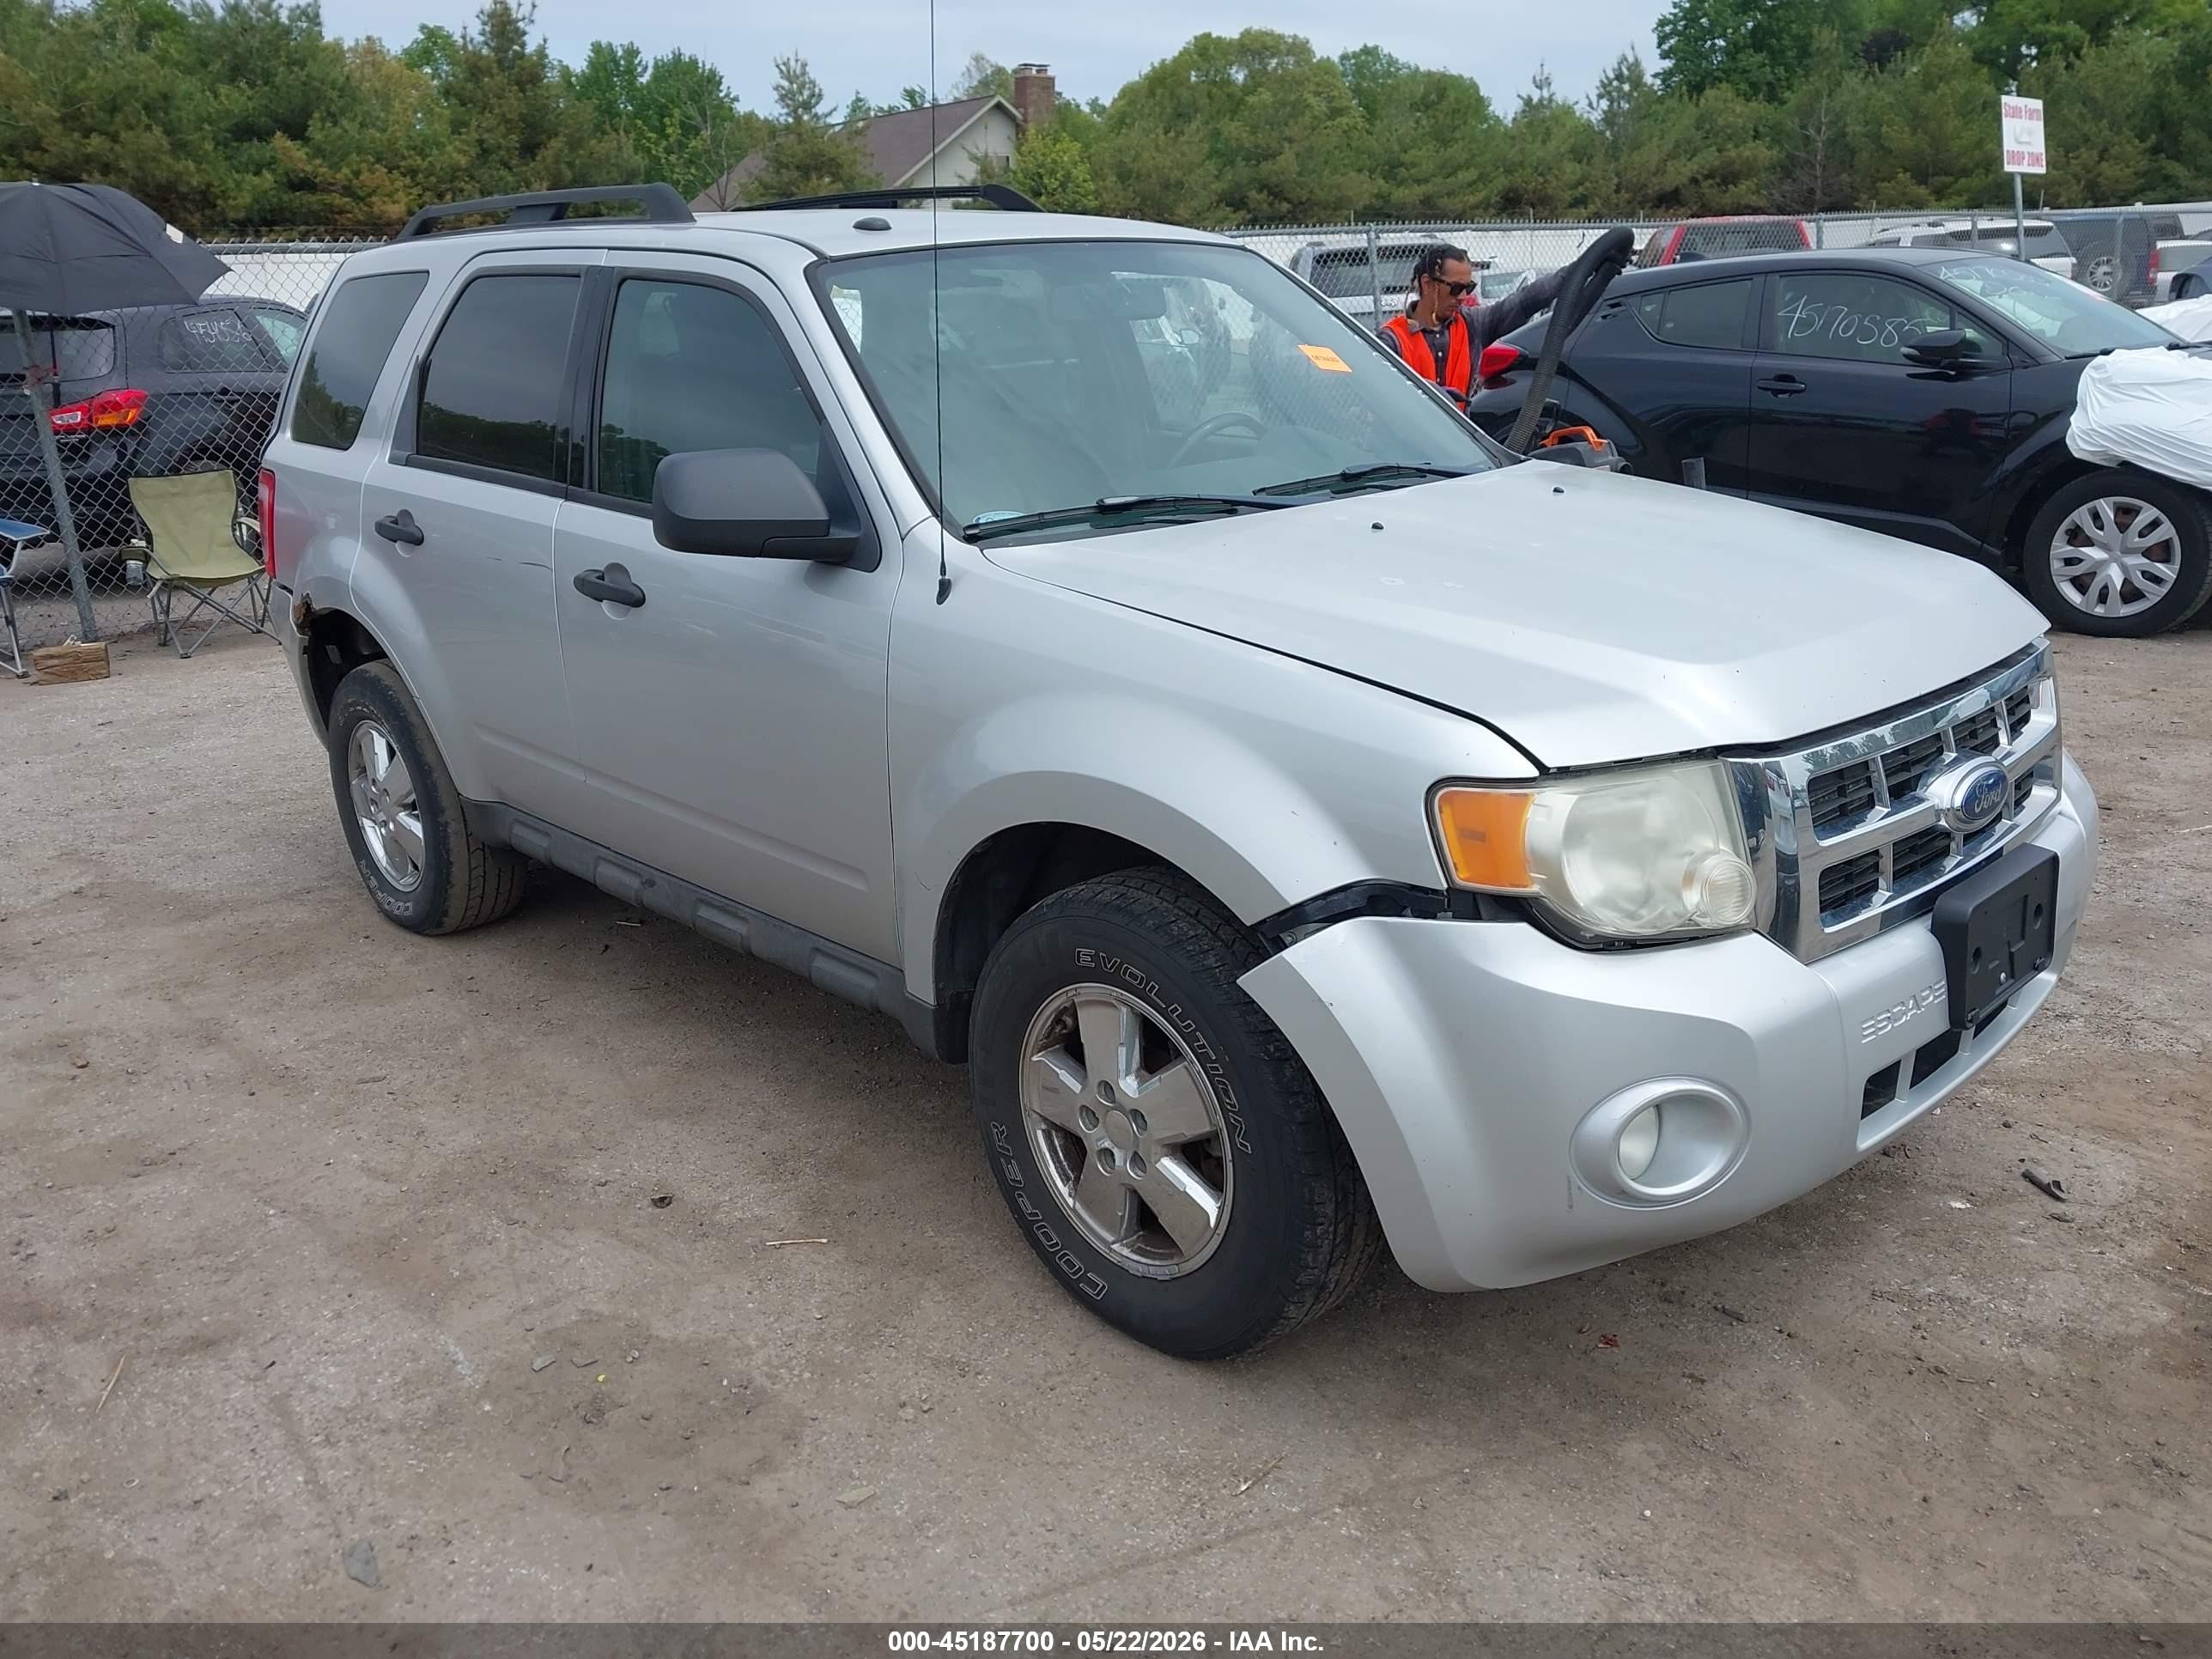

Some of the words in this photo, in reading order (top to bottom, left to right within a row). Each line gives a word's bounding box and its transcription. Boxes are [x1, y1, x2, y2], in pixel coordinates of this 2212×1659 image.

[2003, 103, 2022, 119] State
[2025, 104, 2042, 121] Farm
[2006, 149, 2025, 166] DROP
[2027, 151, 2044, 167] ZONE
[1975, 779, 2002, 813] Ford
[1861, 981, 1946, 1043] ESCAPE
[1074, 948, 1252, 1154] EVOLUTION
[990, 1121, 1108, 1301] COOPER
